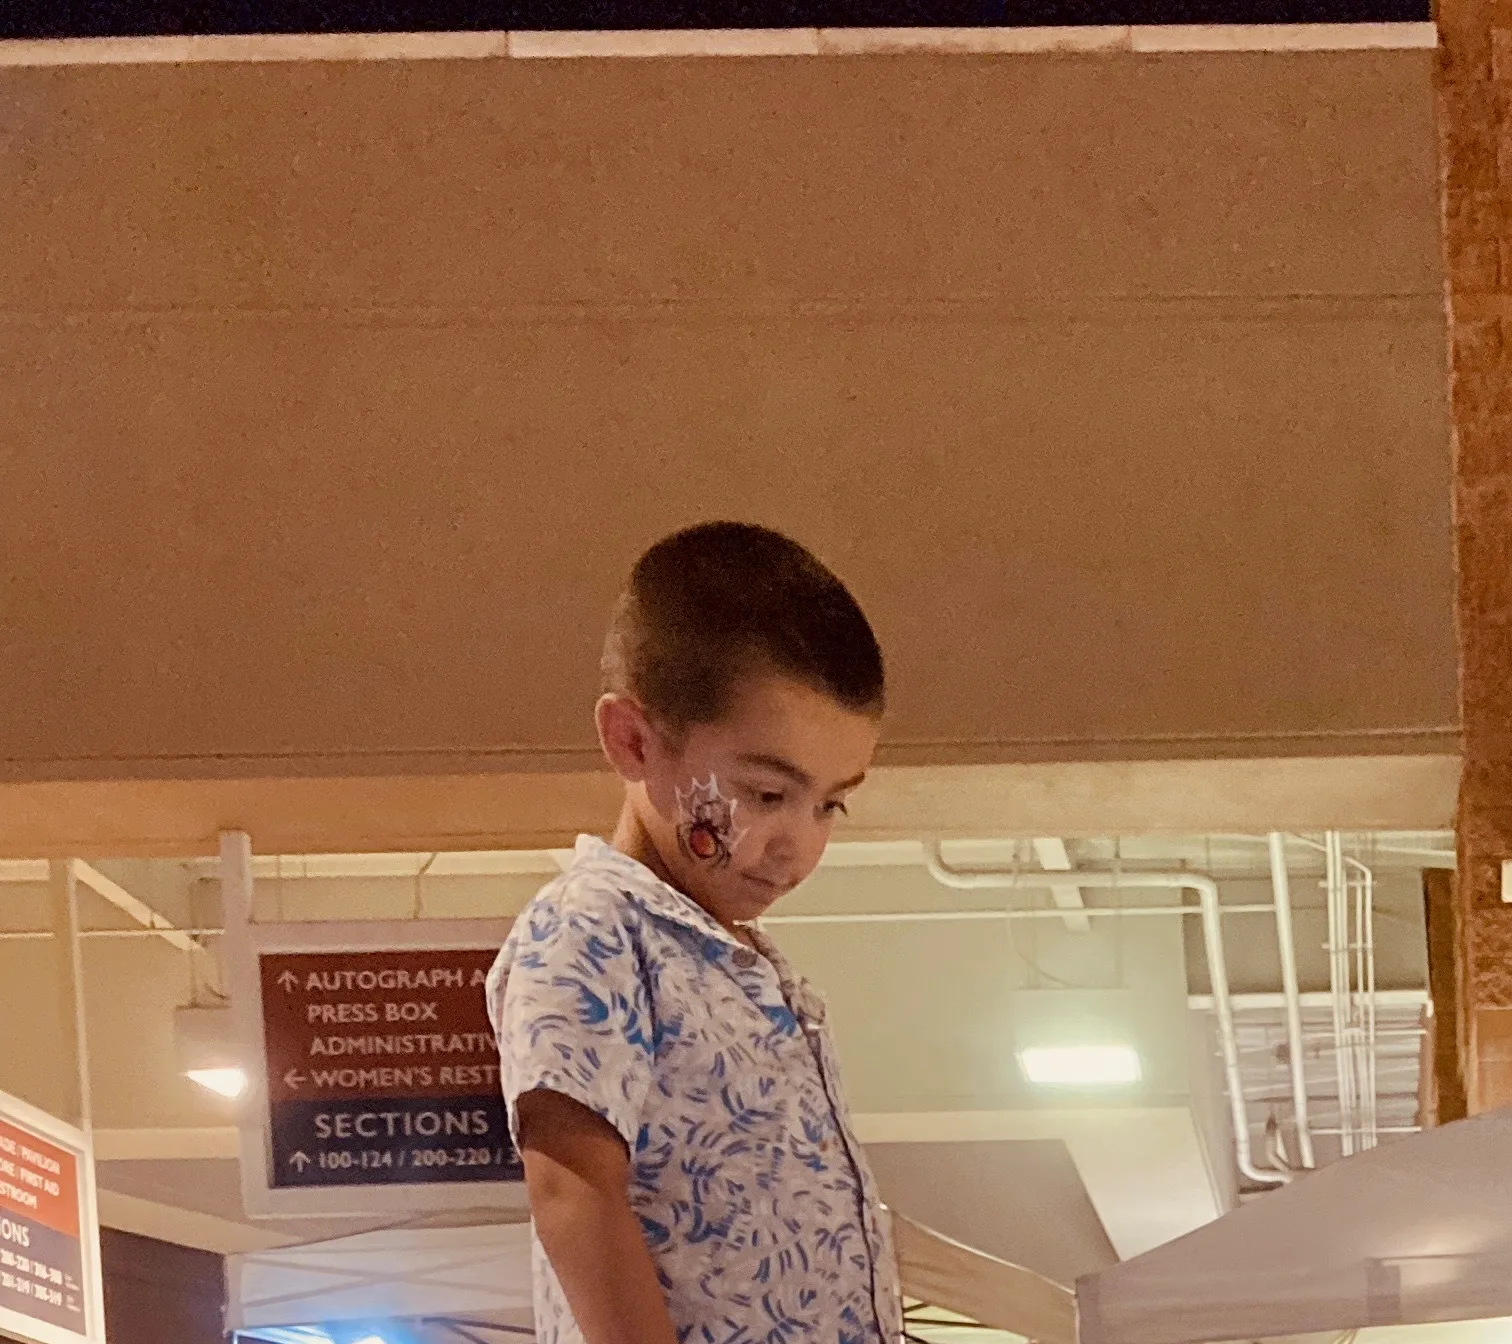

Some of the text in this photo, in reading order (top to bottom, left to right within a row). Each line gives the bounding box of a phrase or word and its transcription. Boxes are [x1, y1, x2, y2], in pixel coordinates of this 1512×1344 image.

[306, 969, 464, 991] AUTOGRAPH
[307, 1002, 438, 1024] PRESS BOX
[310, 1032, 497, 1056] ADMINISTRATIV
[311, 1065, 500, 1089] WOMEN'S REST
[315, 1110, 490, 1138] SECTIONS
[319, 1150, 392, 1170] 100-124
[413, 1148, 491, 1168] 200-220
[0, 1217, 30, 1248] ONS
